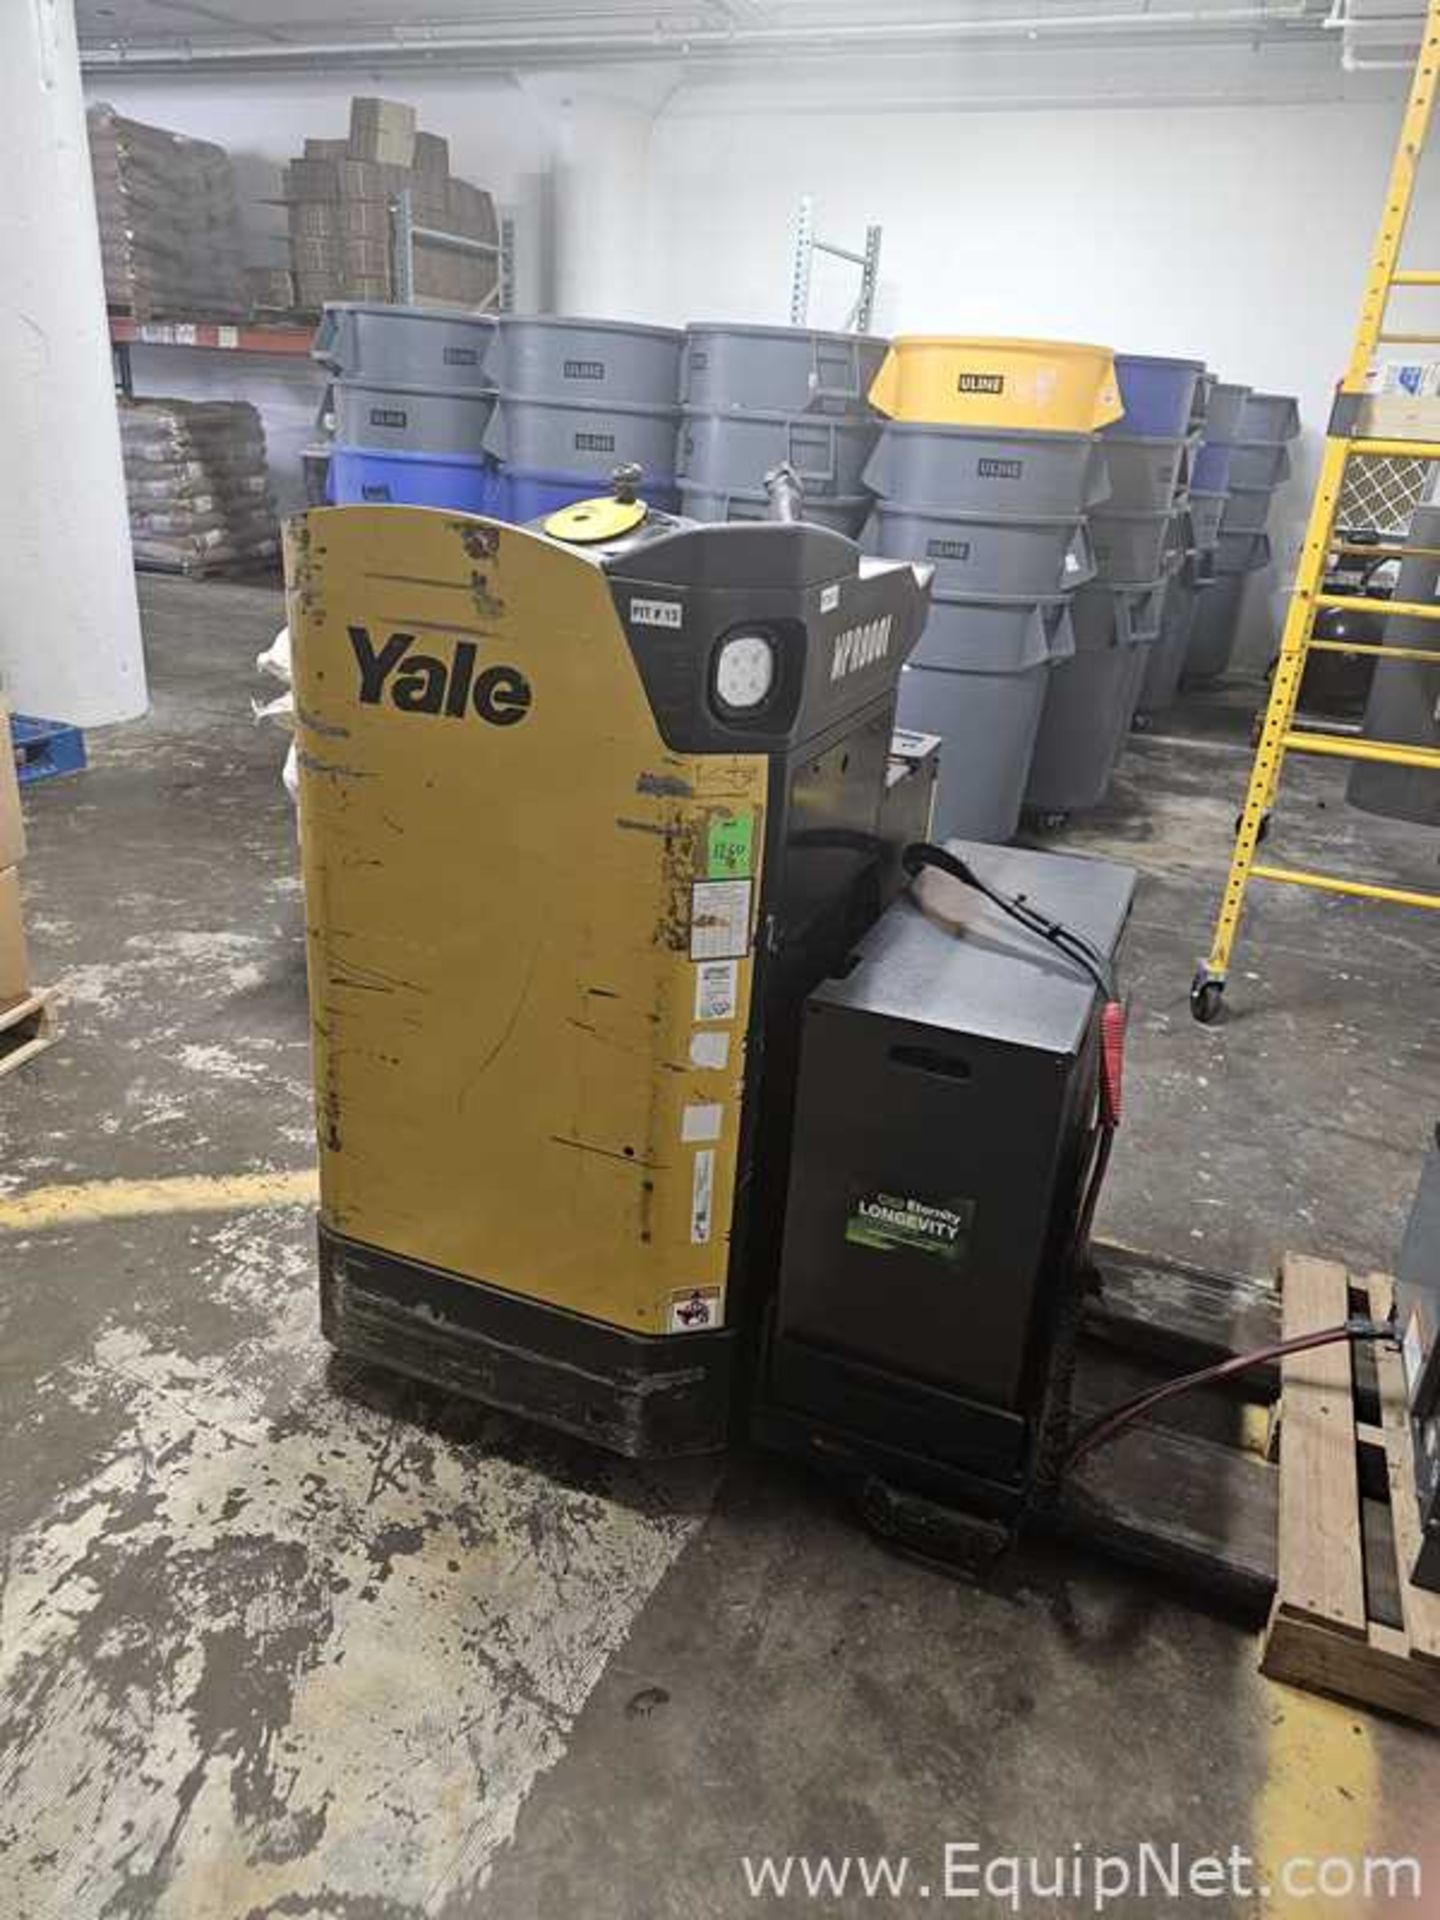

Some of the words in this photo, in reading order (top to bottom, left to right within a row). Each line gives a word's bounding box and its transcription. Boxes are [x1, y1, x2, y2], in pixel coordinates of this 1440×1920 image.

[959, 374, 1002, 393] ULINE
[347, 626, 532, 727] Yale
[859, 1200, 959, 1239] LONGEVITY
